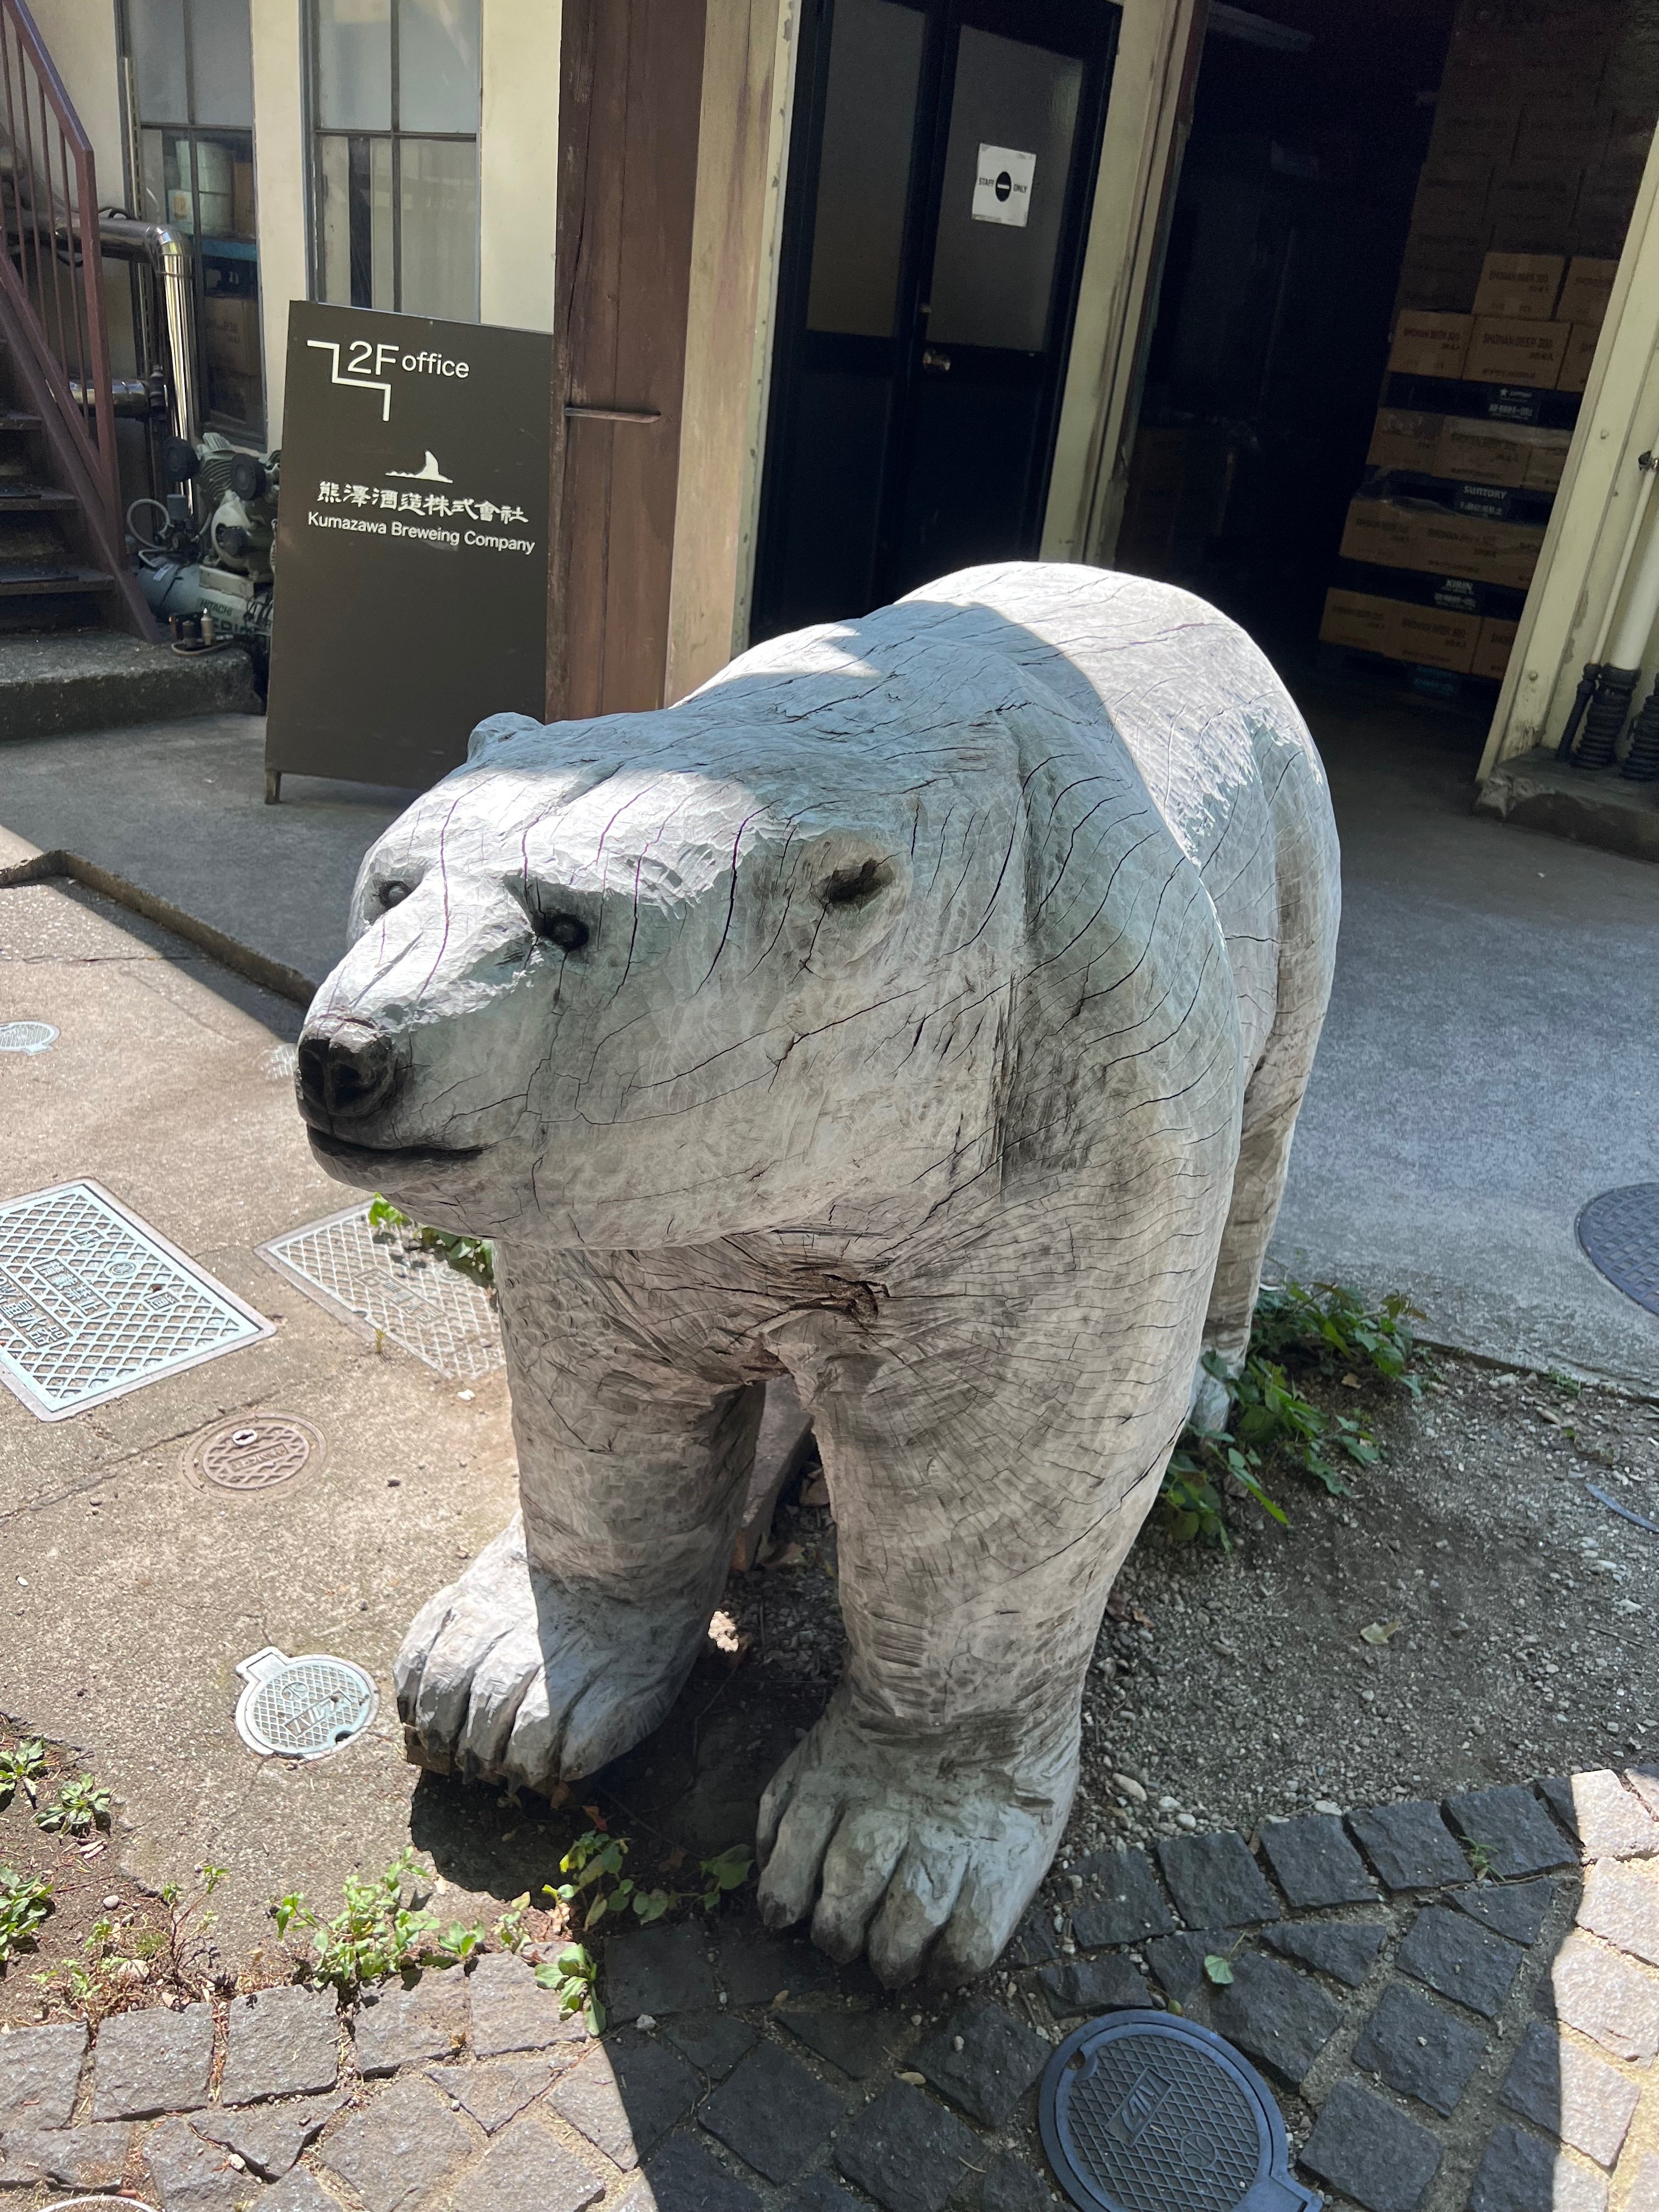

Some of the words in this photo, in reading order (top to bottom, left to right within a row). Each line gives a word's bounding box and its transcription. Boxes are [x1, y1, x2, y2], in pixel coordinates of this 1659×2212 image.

[347, 341, 399, 376] 2F
[402, 352, 470, 379] office
[1463, 485, 1508, 500] SUNTORY
[308, 511, 387, 535] Kumazawa
[391, 521, 460, 546] Breweing
[464, 531, 536, 555] Company
